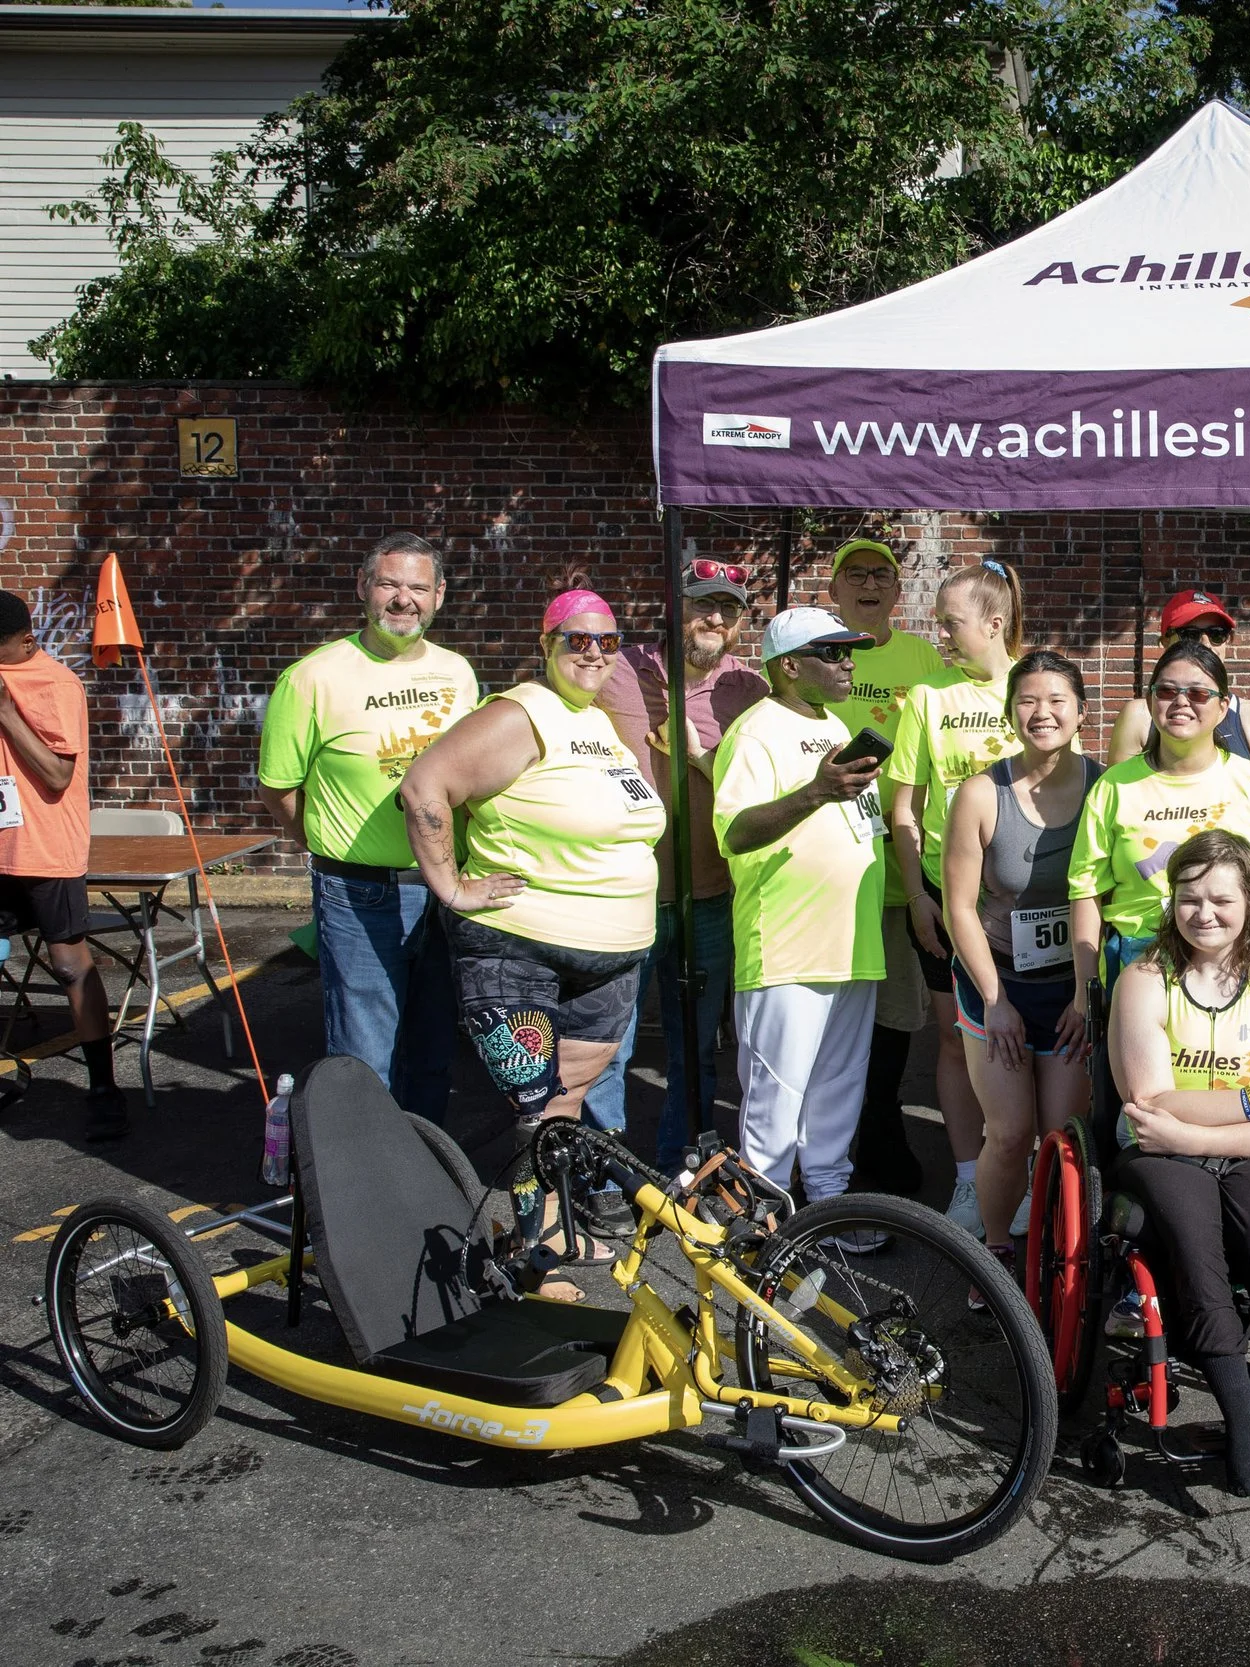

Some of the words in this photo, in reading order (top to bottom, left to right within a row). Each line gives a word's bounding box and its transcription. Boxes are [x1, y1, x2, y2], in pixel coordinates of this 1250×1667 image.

[711, 430, 746, 439] EXTREME
[747, 432, 782, 440] CANOPY
[191, 432, 225, 463] 12
[364, 688, 439, 711] Achilles
[395, 702, 441, 711] INTERNATIONAL
[939, 711, 1008, 730] Achilles
[1143, 806, 1208, 822] Achilles
[1179, 1068, 1240, 1077] INTERNAIONAL
[402, 1399, 551, 1445] force-3
